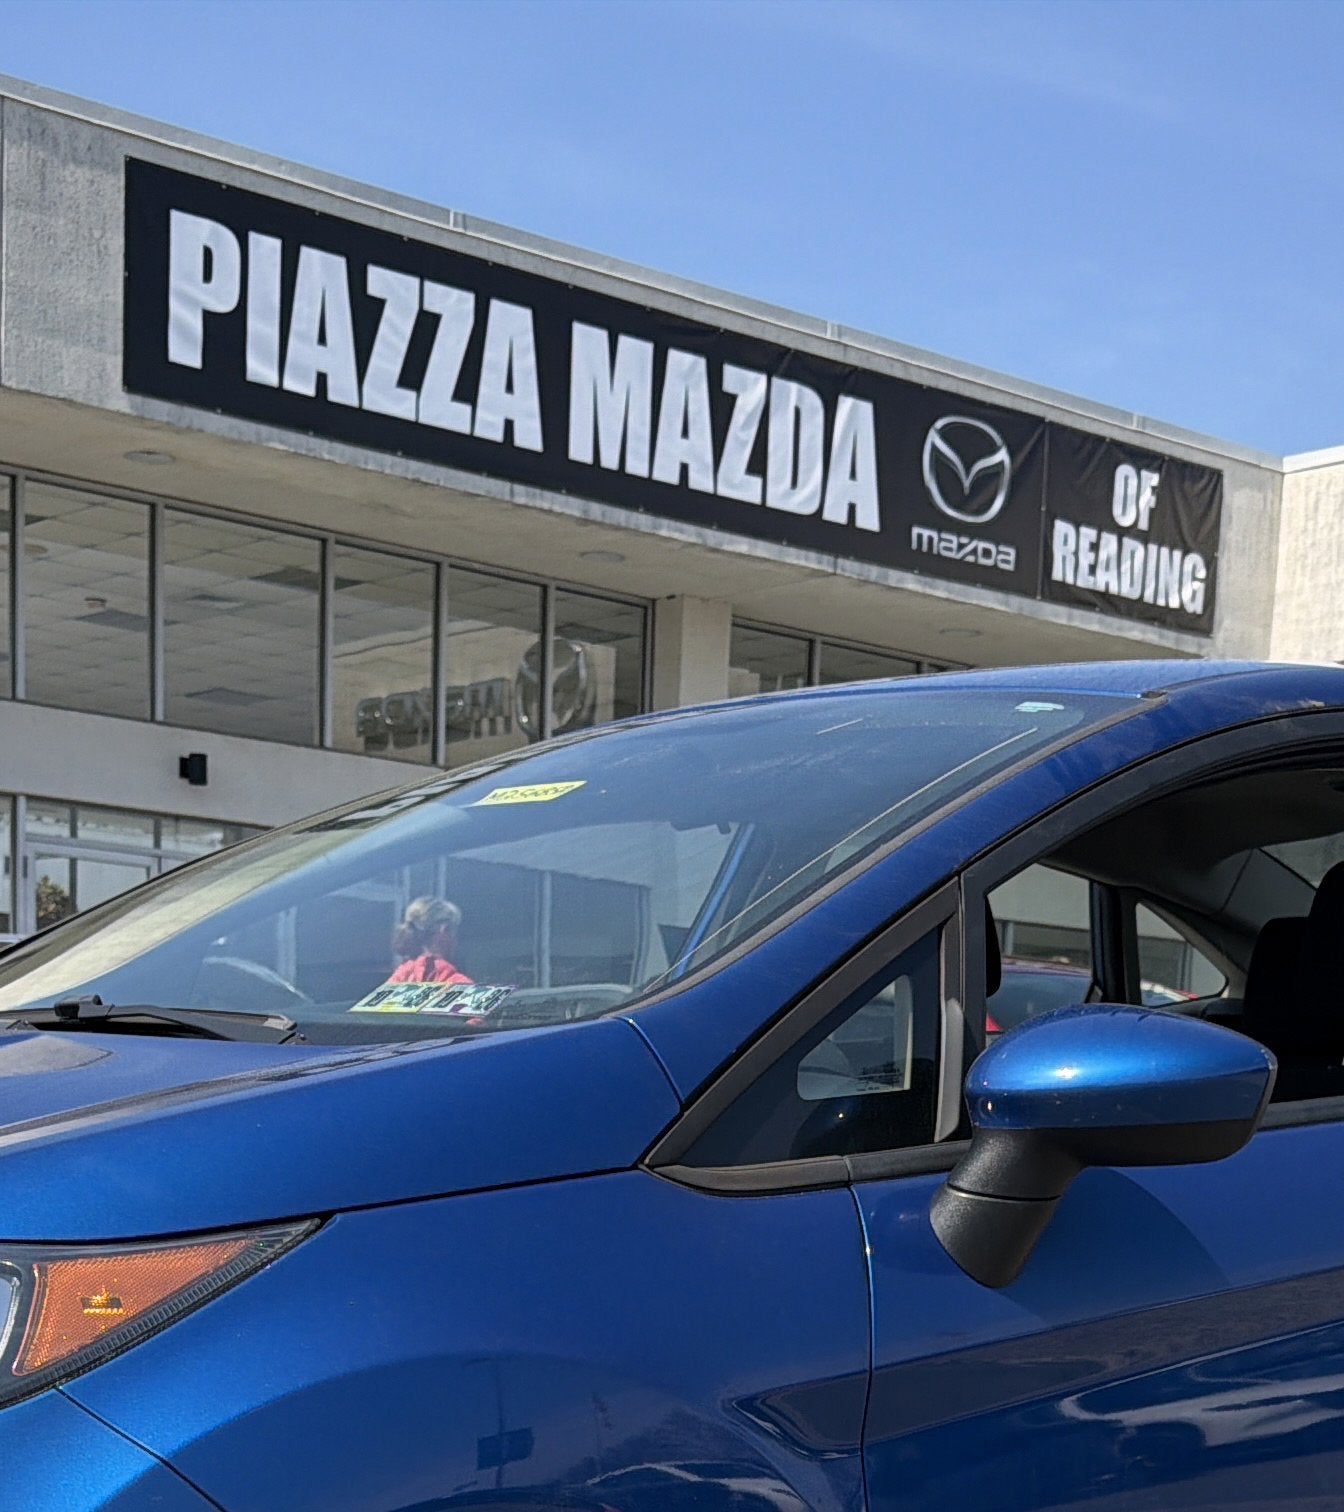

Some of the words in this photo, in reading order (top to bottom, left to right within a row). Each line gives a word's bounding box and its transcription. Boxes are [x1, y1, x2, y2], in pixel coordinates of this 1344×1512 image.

[167, 208, 544, 453] PIAZZA
[567, 320, 882, 533] MAZDA
[1112, 463, 1160, 531] OF
[911, 526, 1017, 573] mazda
[1051, 518, 1208, 615] READING
